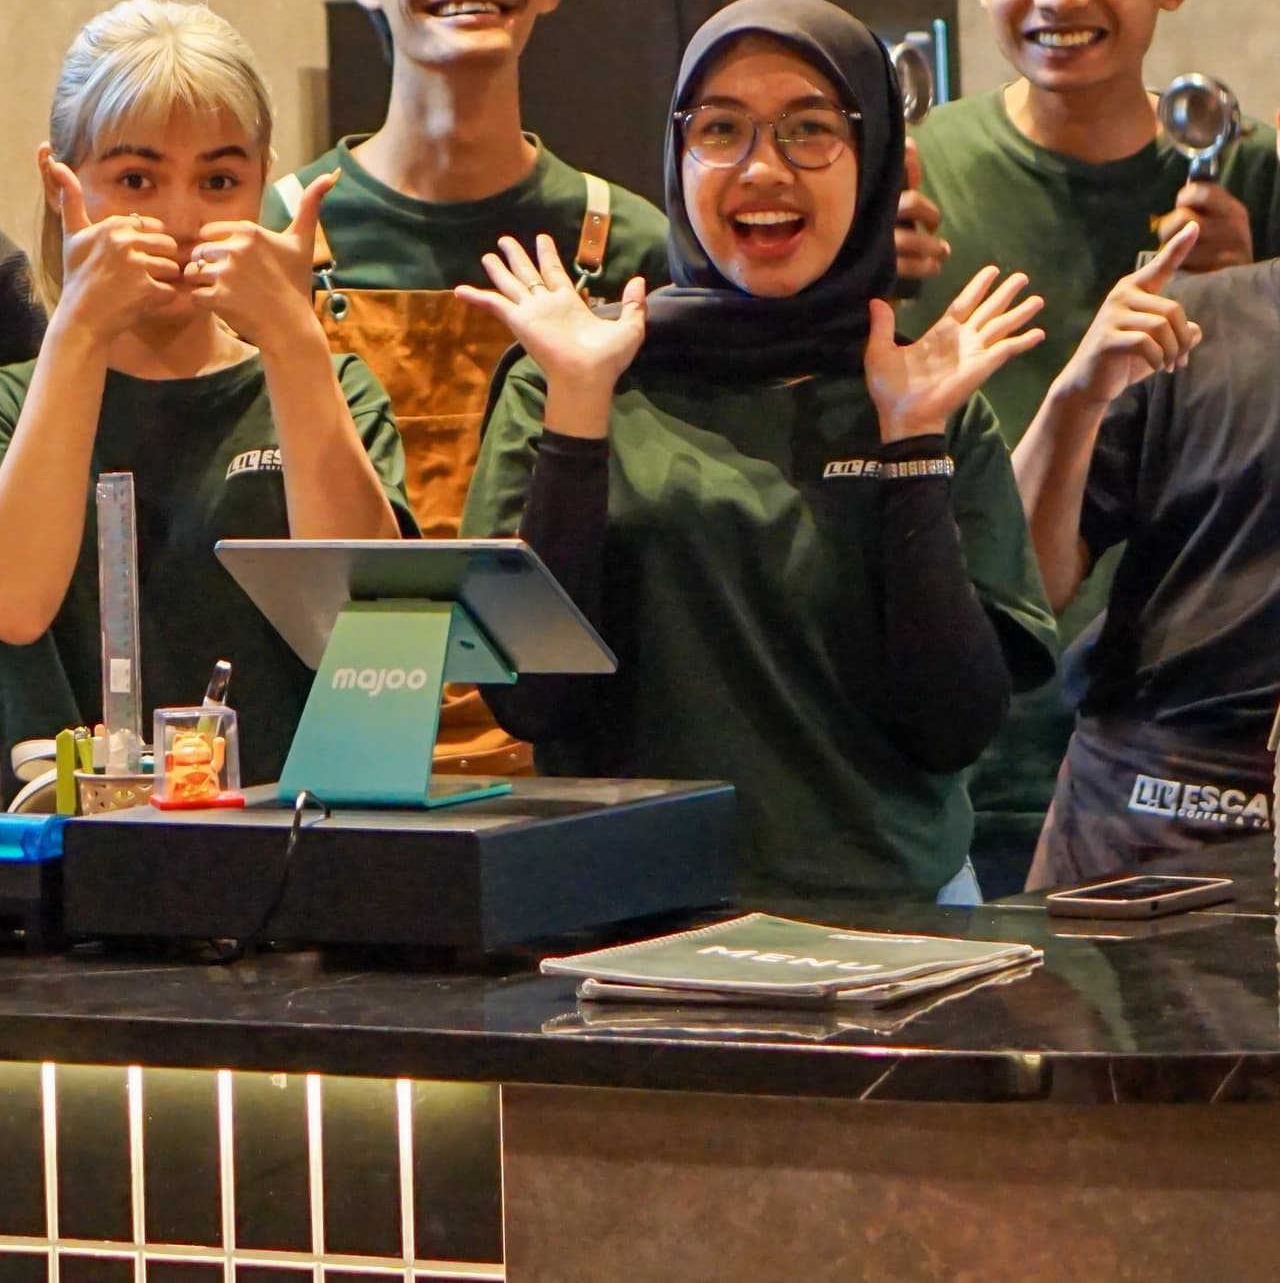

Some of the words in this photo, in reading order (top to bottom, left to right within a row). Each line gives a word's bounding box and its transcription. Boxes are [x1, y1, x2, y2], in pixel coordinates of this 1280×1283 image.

[331, 667, 427, 697] majoo
[1181, 784, 1269, 818] ESCA
[696, 945, 884, 971] MENU
